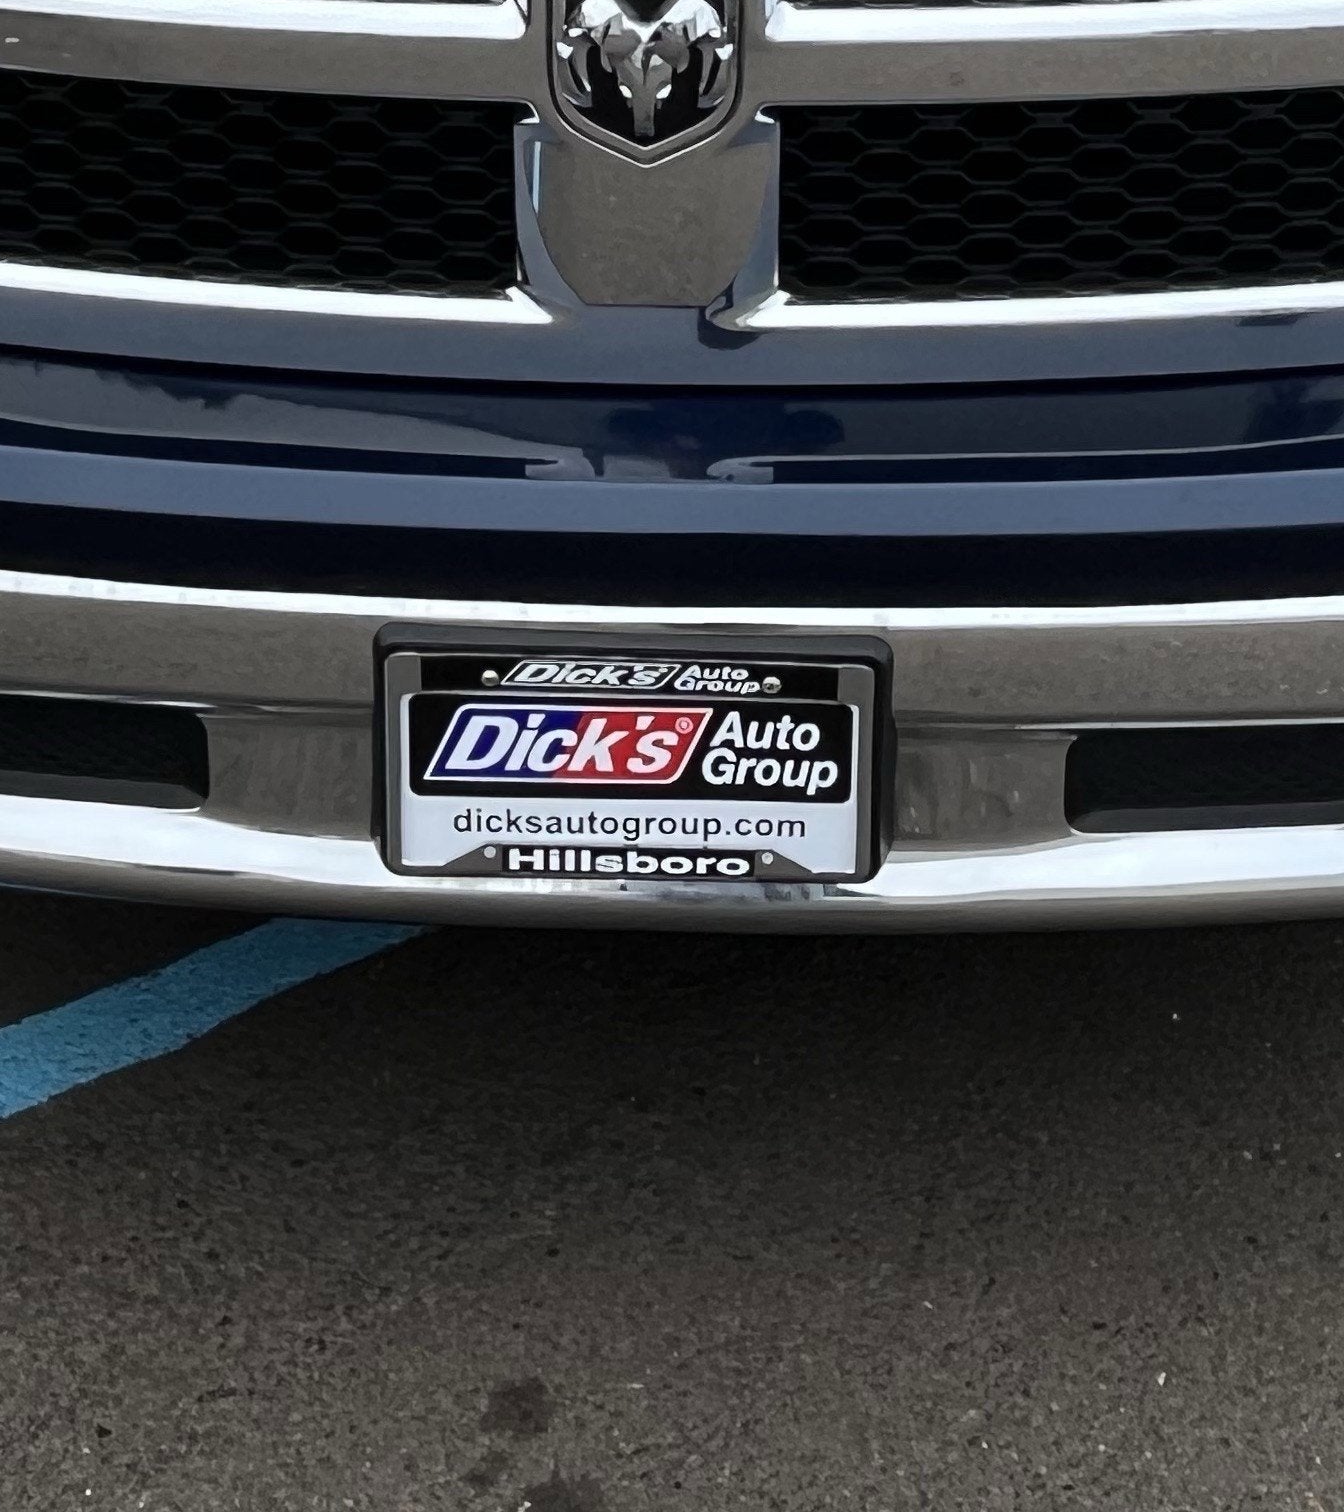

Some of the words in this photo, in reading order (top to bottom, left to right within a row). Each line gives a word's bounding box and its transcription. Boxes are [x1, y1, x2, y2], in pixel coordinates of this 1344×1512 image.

[513, 661, 661, 686] Dick's
[679, 664, 750, 681] Auto
[674, 677, 761, 694] Group
[444, 712, 681, 774] Dick's
[709, 711, 821, 752] Auto
[701, 747, 839, 796] Group
[452, 808, 807, 842] dicksautogroup.com
[507, 848, 751, 877] Hillsboro
